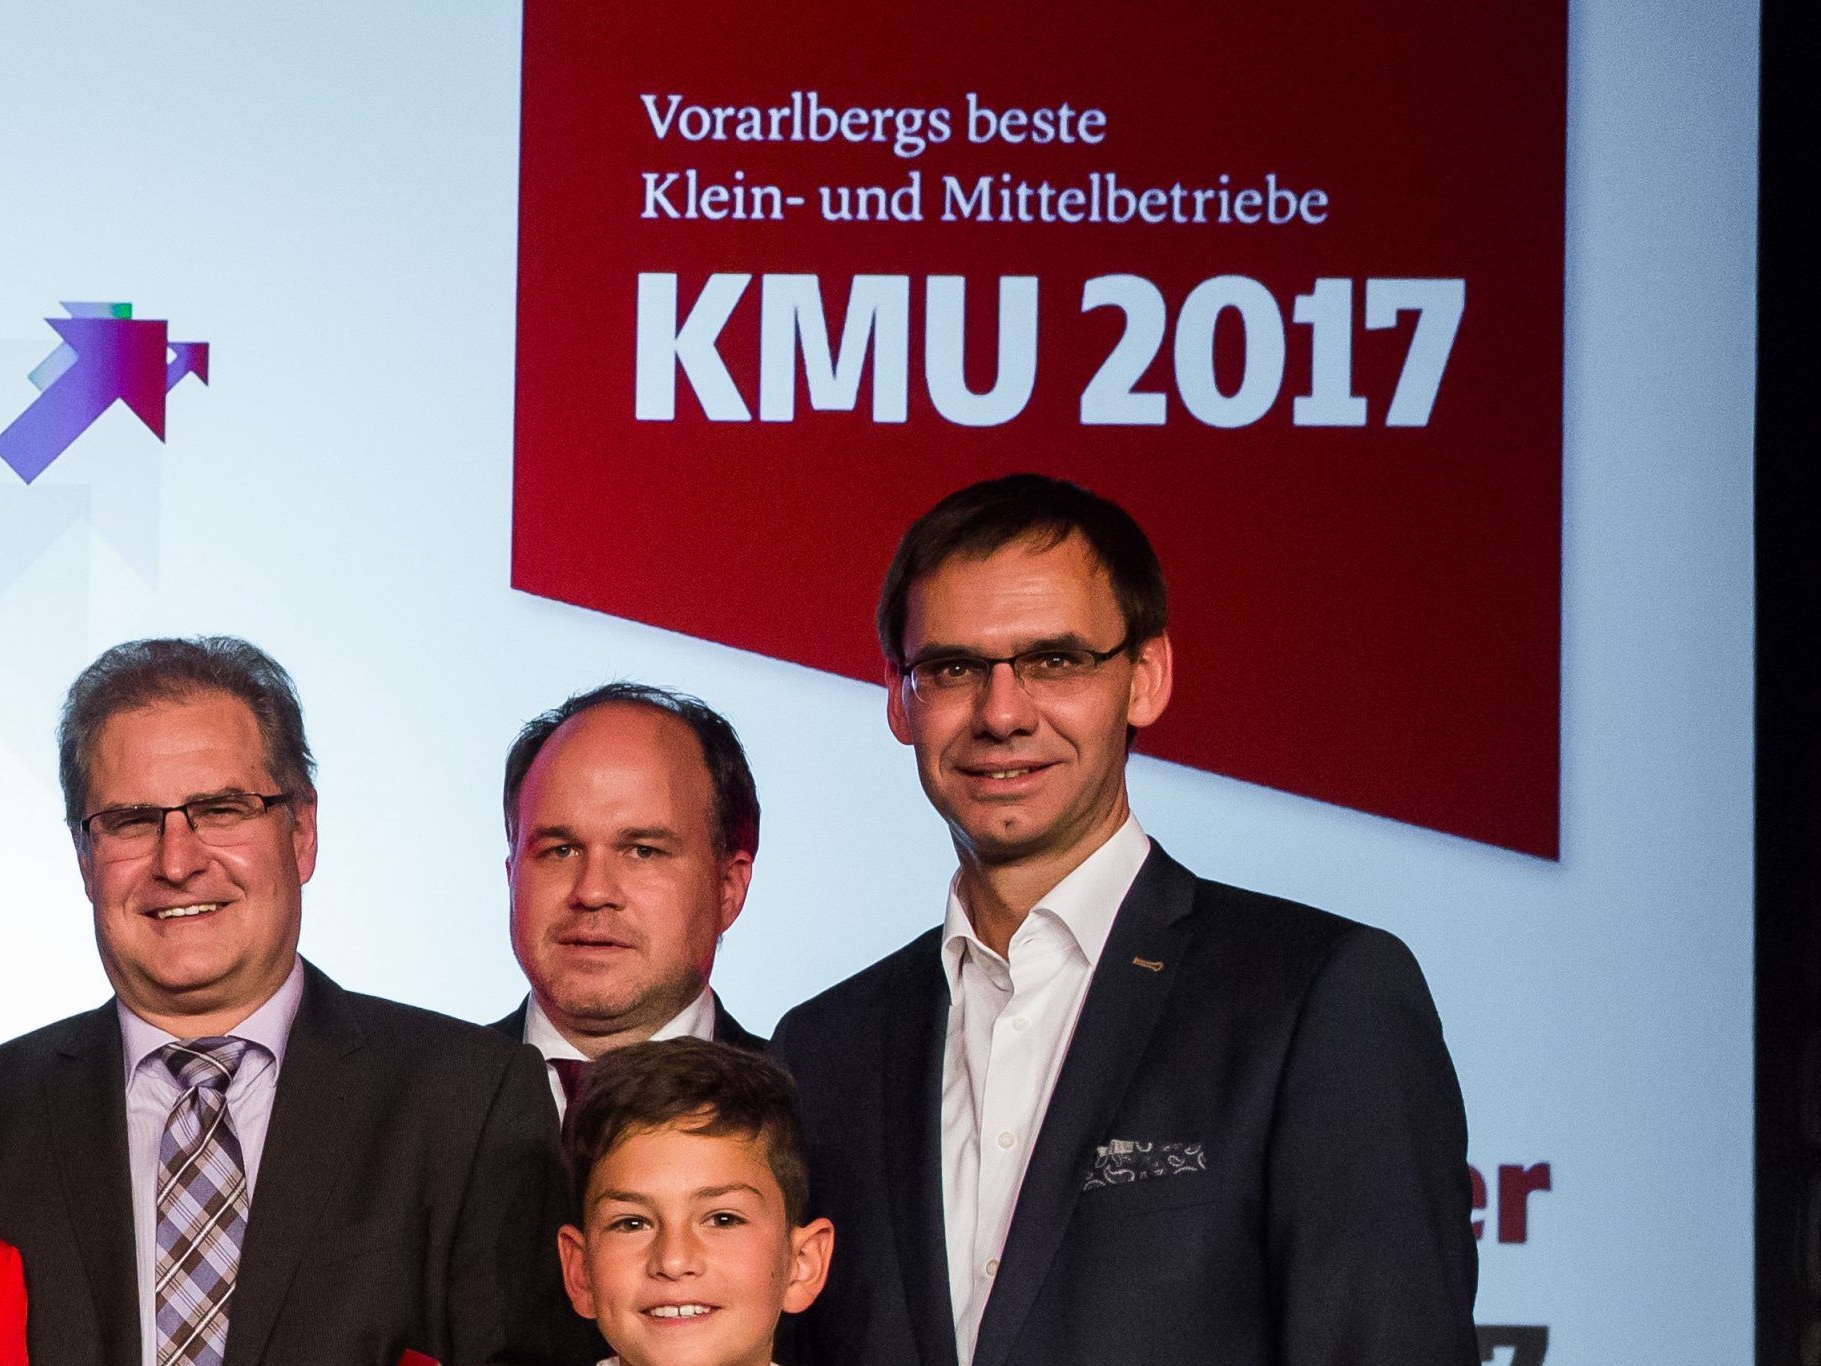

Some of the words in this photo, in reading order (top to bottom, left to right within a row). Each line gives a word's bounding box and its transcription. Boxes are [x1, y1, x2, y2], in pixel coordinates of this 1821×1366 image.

[641, 92, 952, 158] Vorarlbergs
[967, 93, 1108, 144] beste
[641, 169, 805, 222] Klein-
[820, 171, 924, 221] und
[940, 173, 1330, 225] Mittelbetriebe
[635, 272, 1040, 426] KMU
[1079, 274, 1468, 428] 2017
